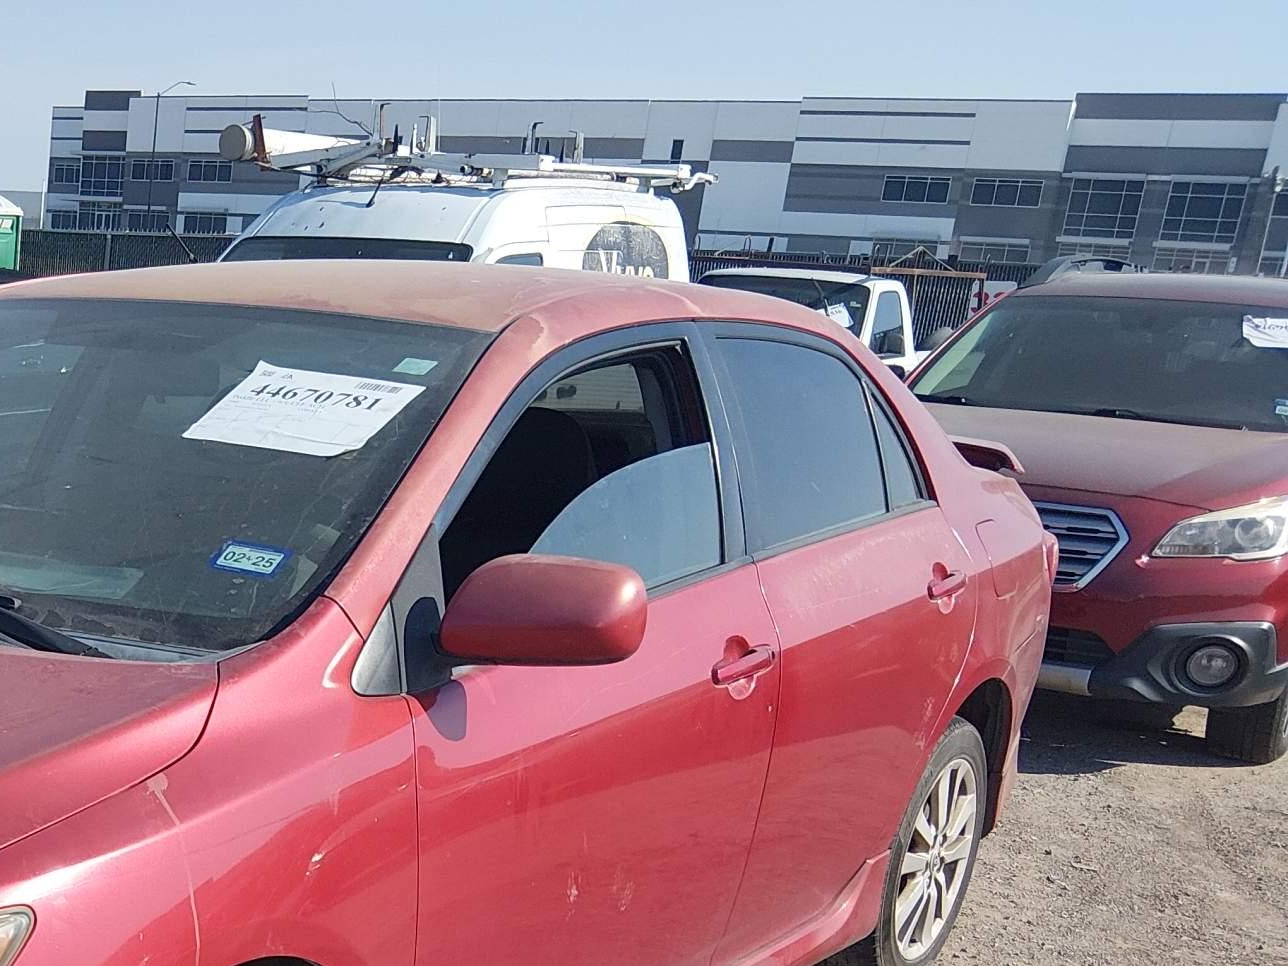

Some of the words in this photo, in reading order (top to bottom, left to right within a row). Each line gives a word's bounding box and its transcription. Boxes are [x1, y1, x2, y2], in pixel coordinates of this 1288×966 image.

[249, 383, 384, 411] 44670781
[223, 551, 247, 564] 02
[251, 555, 277, 569] 25
